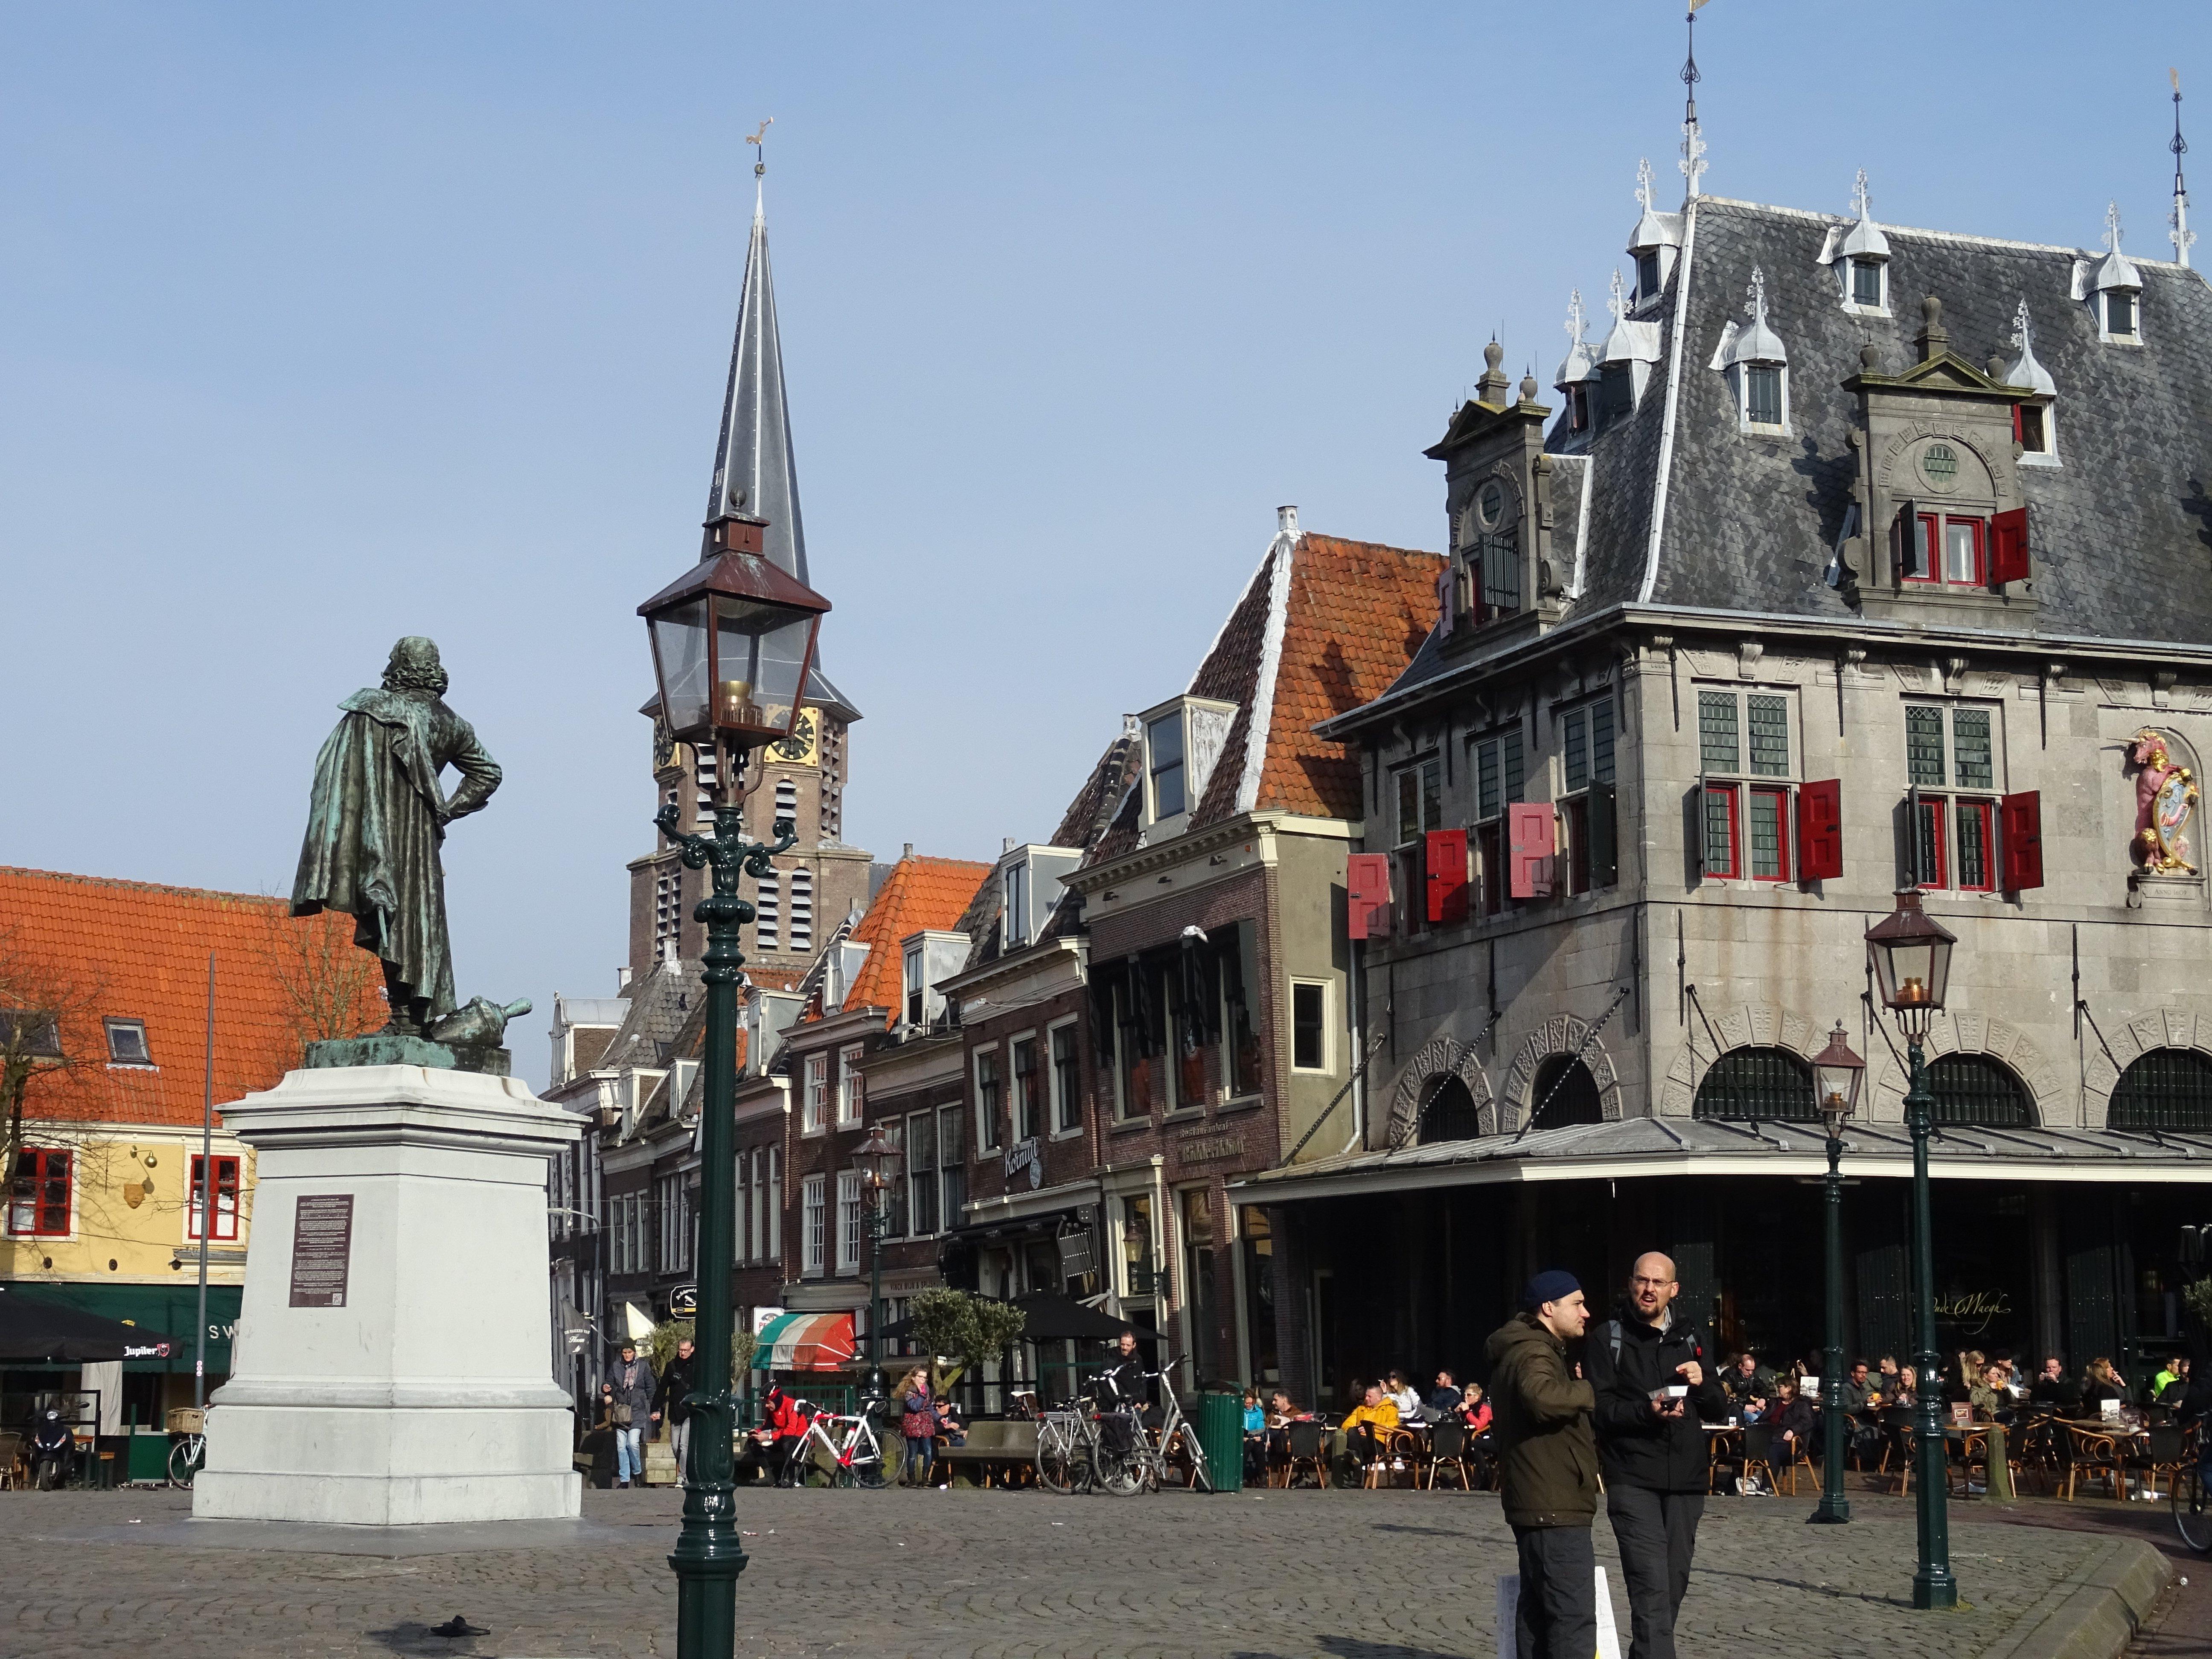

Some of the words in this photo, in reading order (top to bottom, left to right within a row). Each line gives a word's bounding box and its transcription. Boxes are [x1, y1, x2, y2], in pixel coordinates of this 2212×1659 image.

[1005, 1136, 1037, 1178] Kornuit
[1954, 1288, 2011, 1335] Waegh
[124, 1346, 157, 1357] Jupiler
